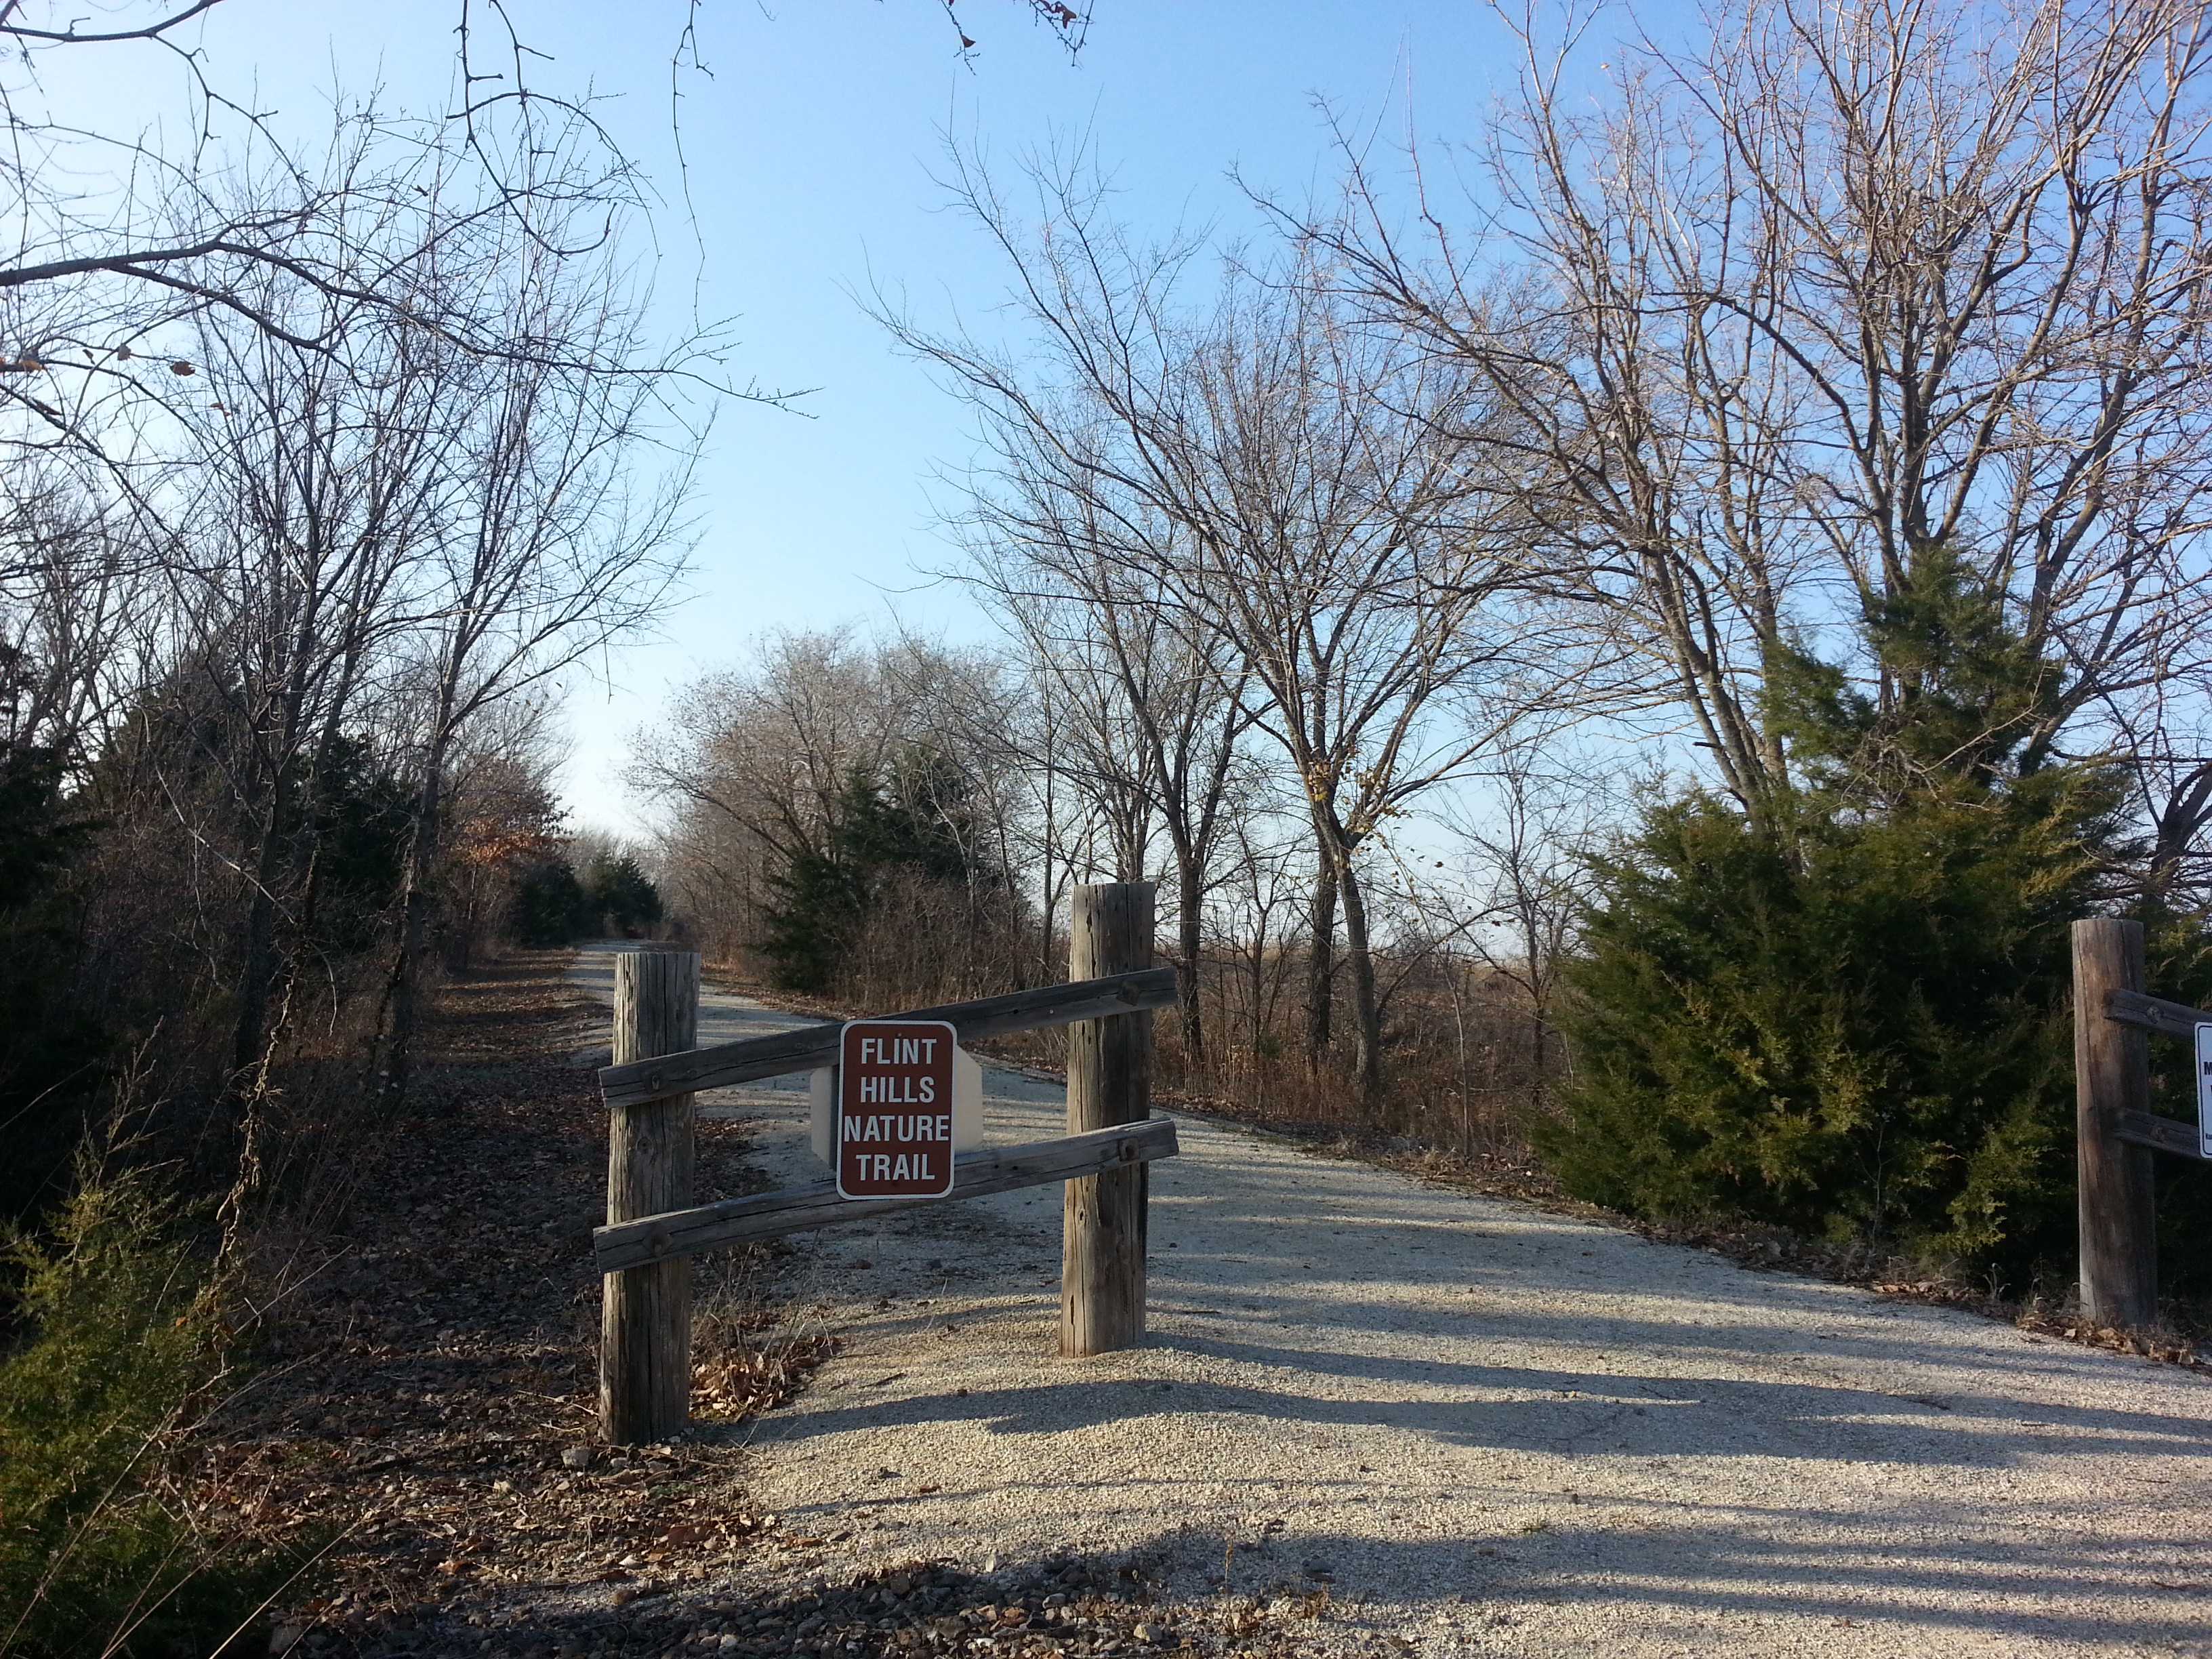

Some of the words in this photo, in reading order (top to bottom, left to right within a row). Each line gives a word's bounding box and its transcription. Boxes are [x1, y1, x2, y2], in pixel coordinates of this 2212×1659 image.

[861, 1038, 937, 1065] FLINT
[860, 1076, 935, 1103] HILLS
[844, 1115, 949, 1142] NATURE
[855, 1153, 935, 1181] TRAIL
